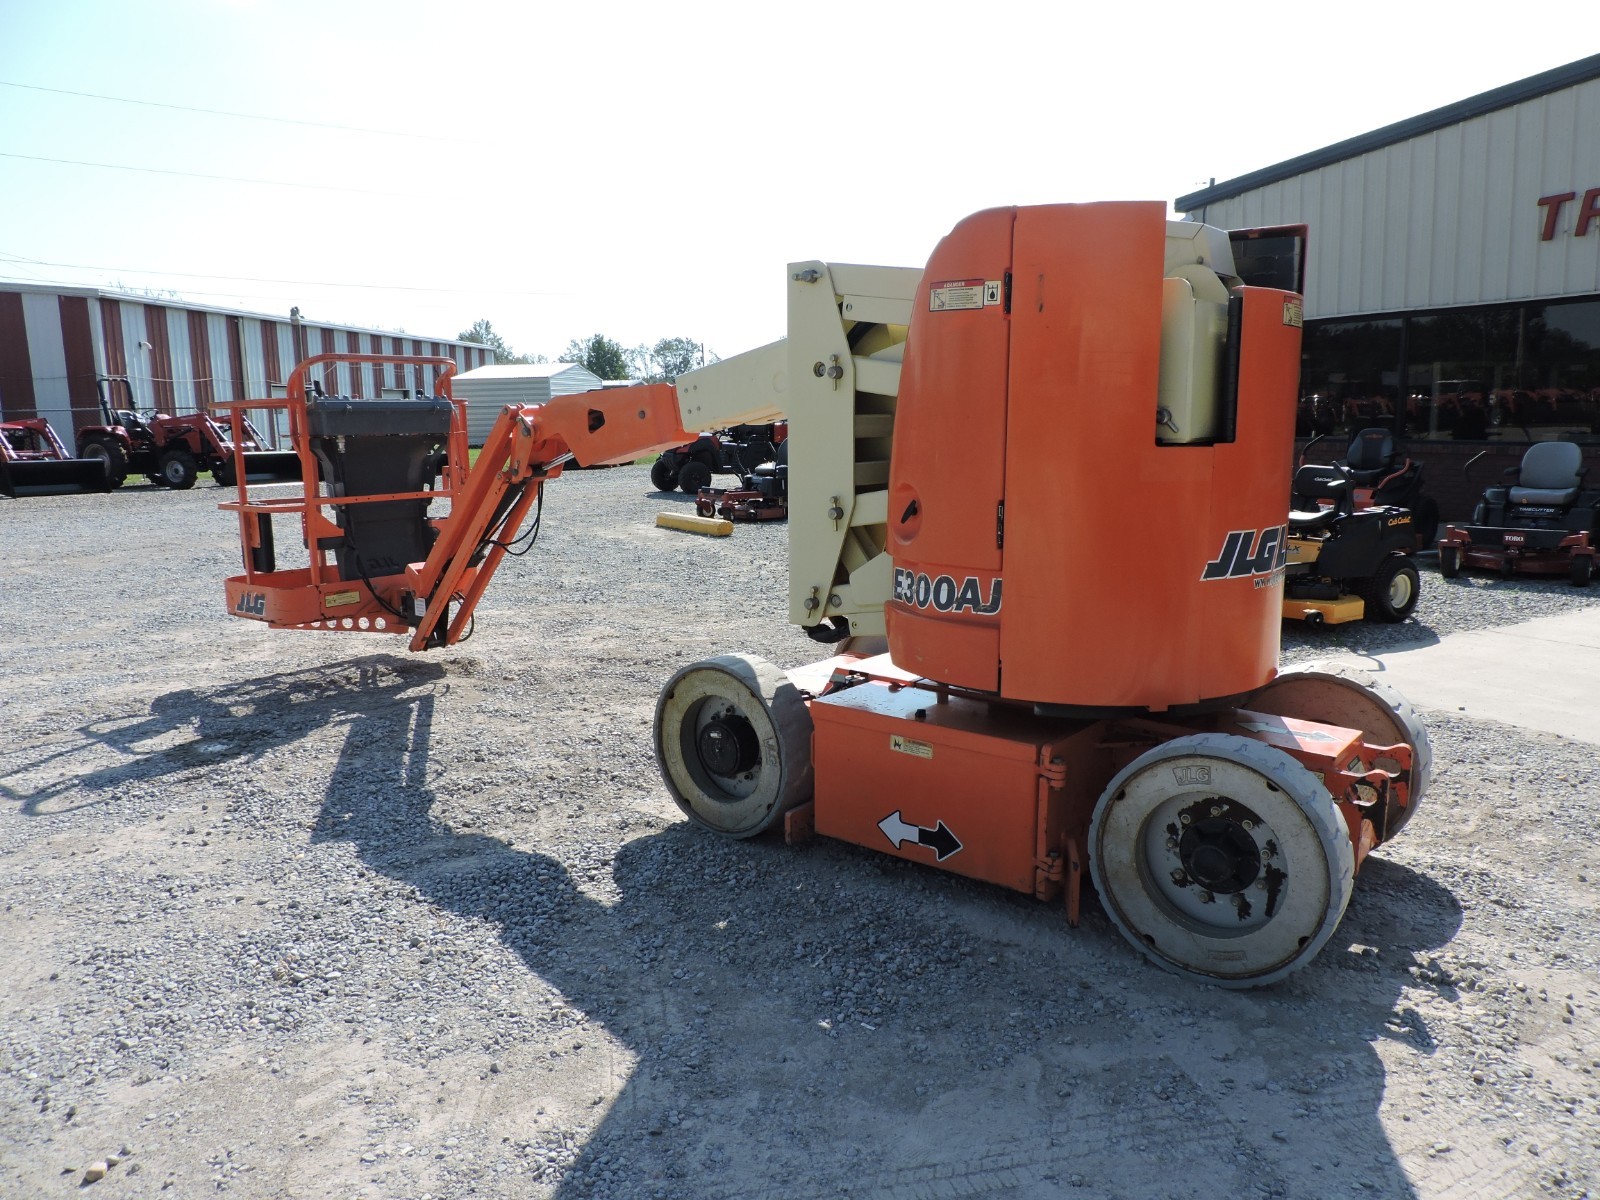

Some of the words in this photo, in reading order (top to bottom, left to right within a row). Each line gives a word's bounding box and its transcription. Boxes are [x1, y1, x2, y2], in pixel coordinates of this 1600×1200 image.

[893, 566, 1003, 615] E300AJ
[235, 591, 267, 617] JLG
[1178, 767, 1210, 784] JLG
